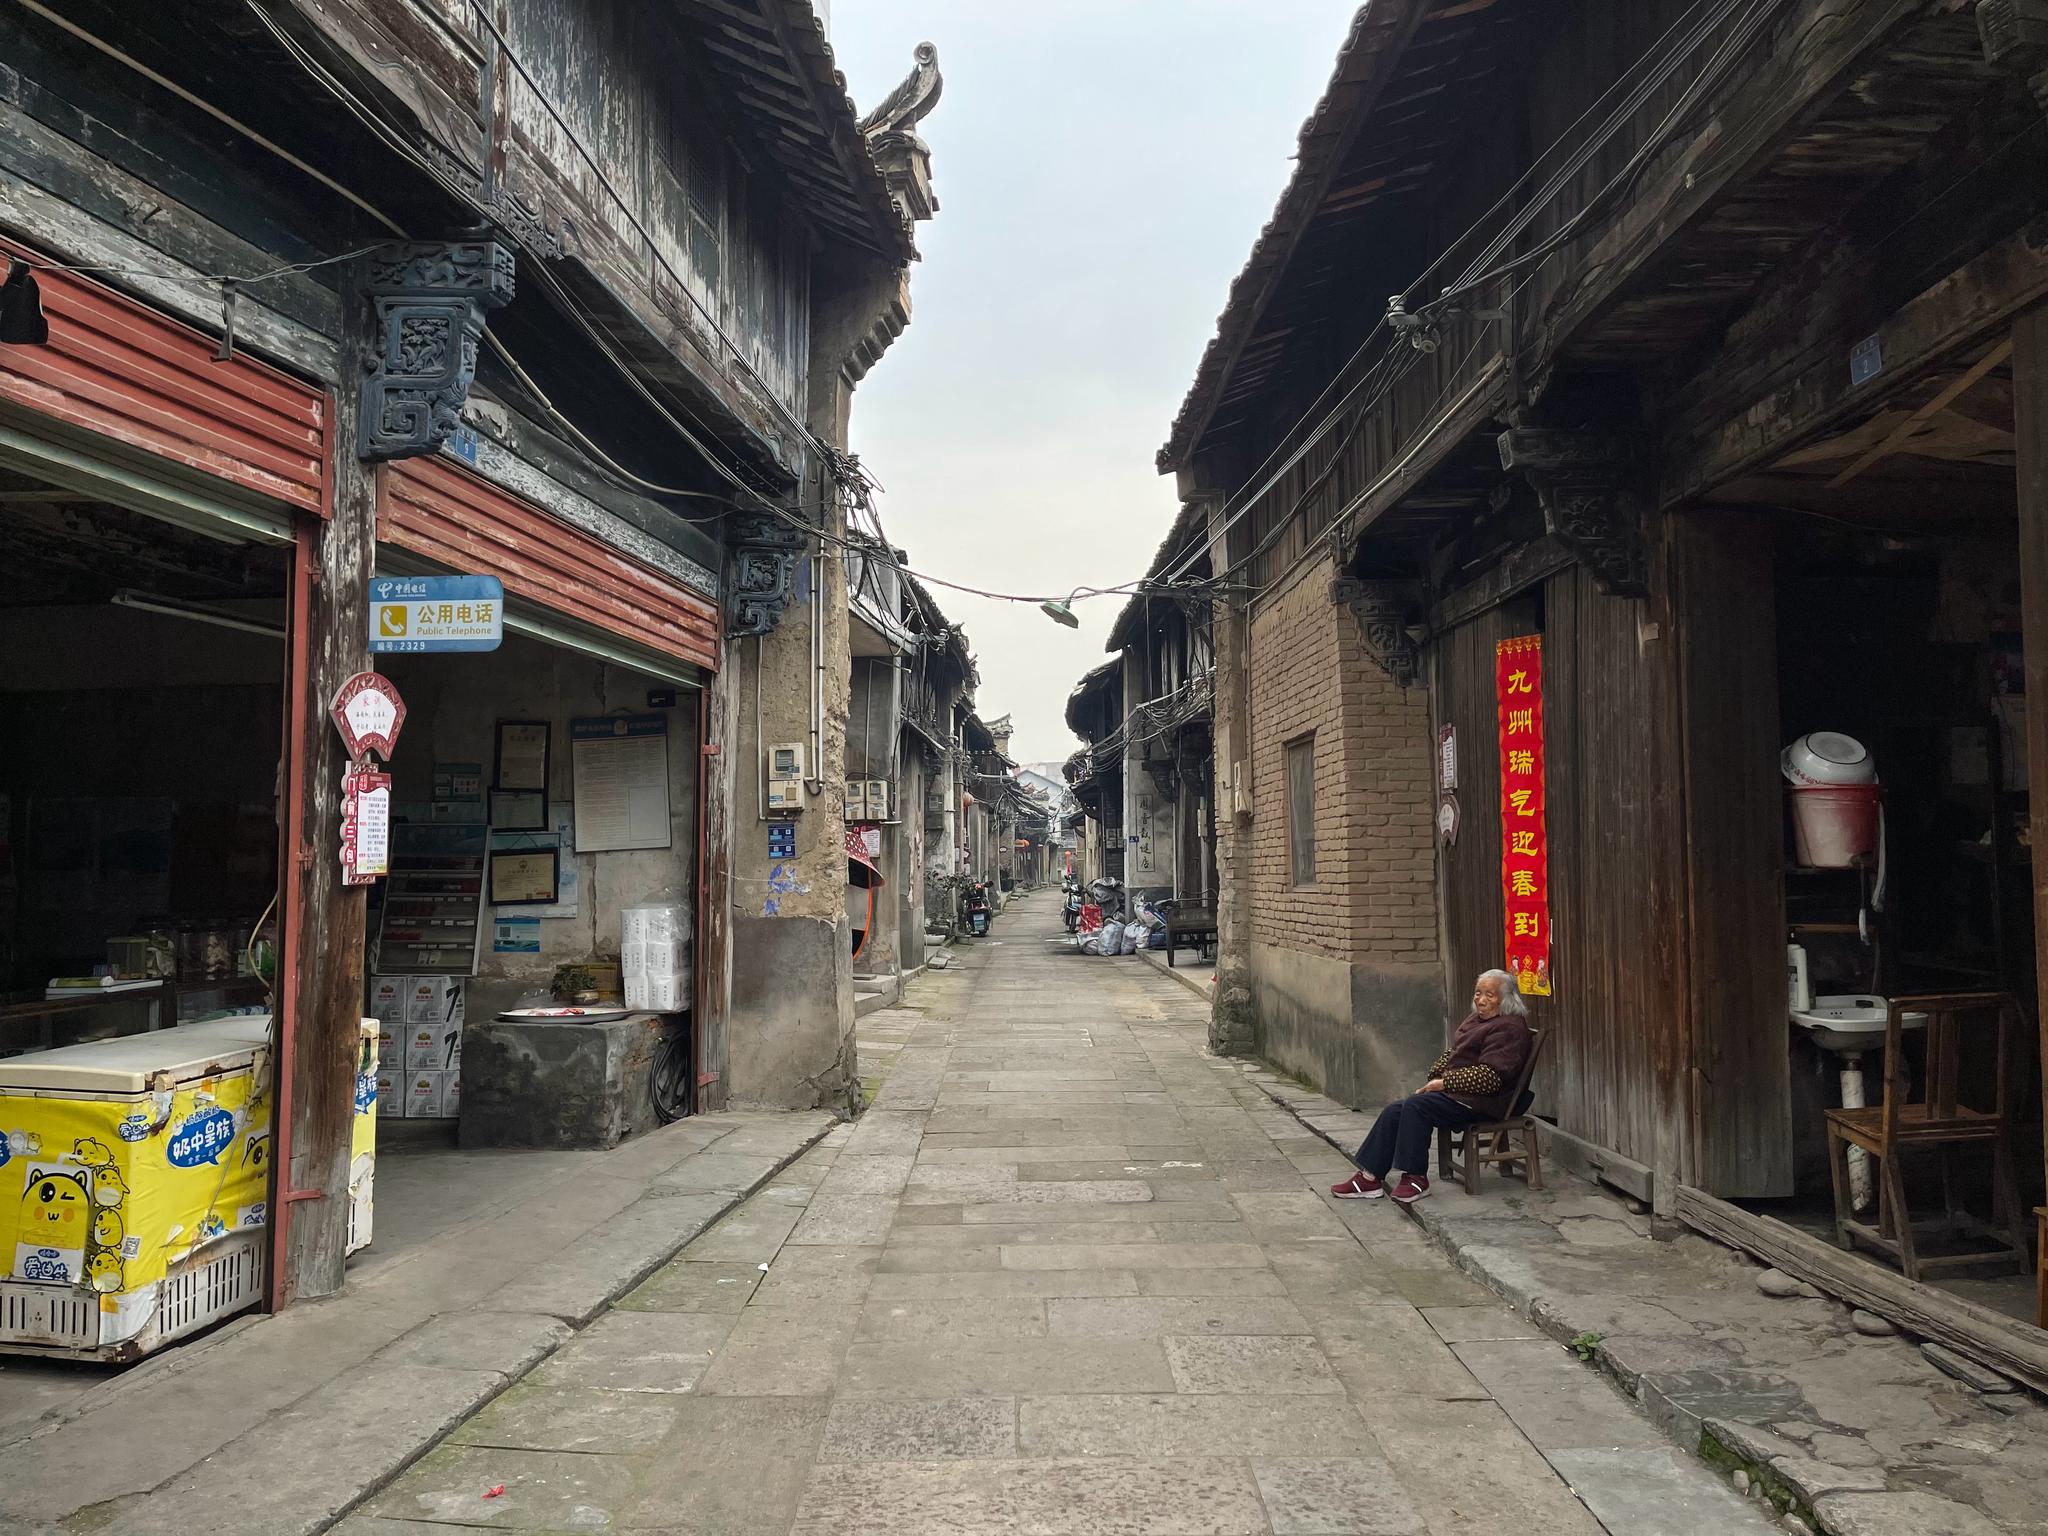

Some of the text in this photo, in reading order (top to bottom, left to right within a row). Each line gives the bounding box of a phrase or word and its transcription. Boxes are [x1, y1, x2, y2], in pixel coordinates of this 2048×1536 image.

[394, 583, 426, 595] 中国电信
[417, 603, 494, 624] 公用电话
[416, 626, 492, 636] Public Telephone
[1507, 668, 1539, 938] 九州瑞气迎春到
[346, 776, 356, 864] 门前三包
[172, 1118, 231, 1160] 奶中皇族
